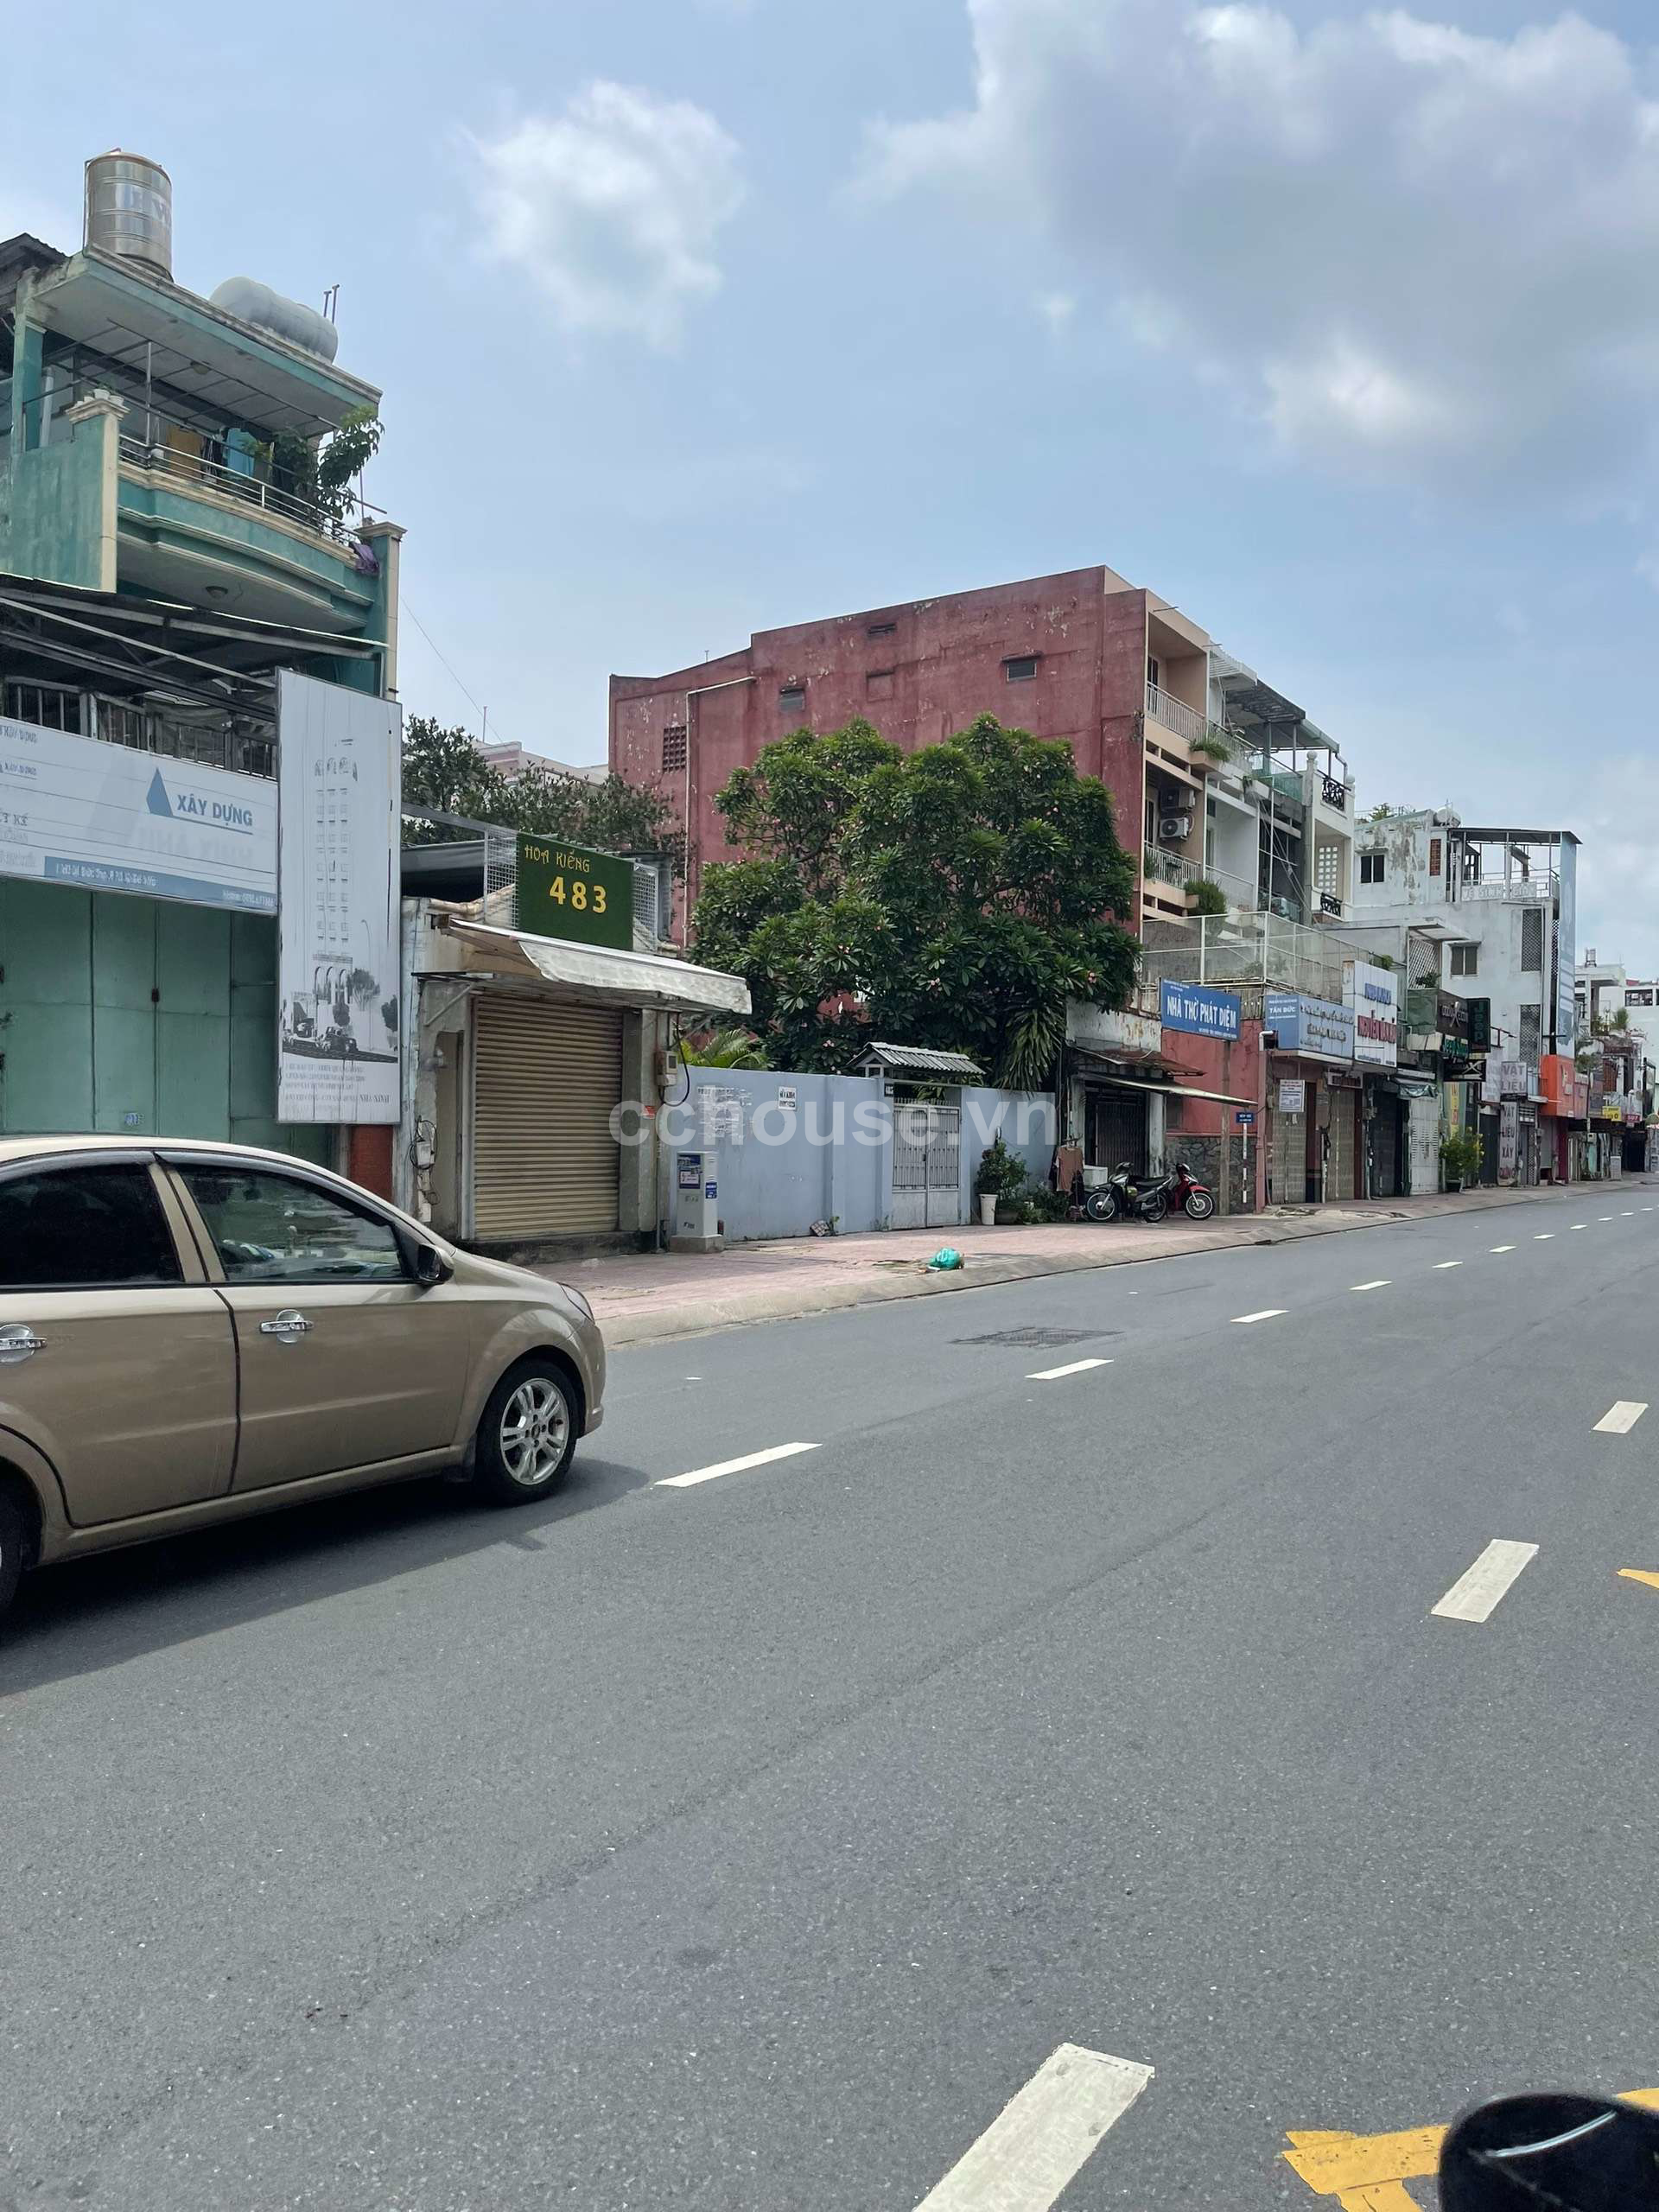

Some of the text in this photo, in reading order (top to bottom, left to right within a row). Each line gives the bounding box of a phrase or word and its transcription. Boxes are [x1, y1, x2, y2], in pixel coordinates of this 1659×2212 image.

[177, 792, 253, 827] XÂY DỰNG
[524, 844, 550, 865] HOA
[549, 875, 607, 913] 483
[1166, 993, 1236, 1031] NHÀ THỜ PHÁT DIỆM
